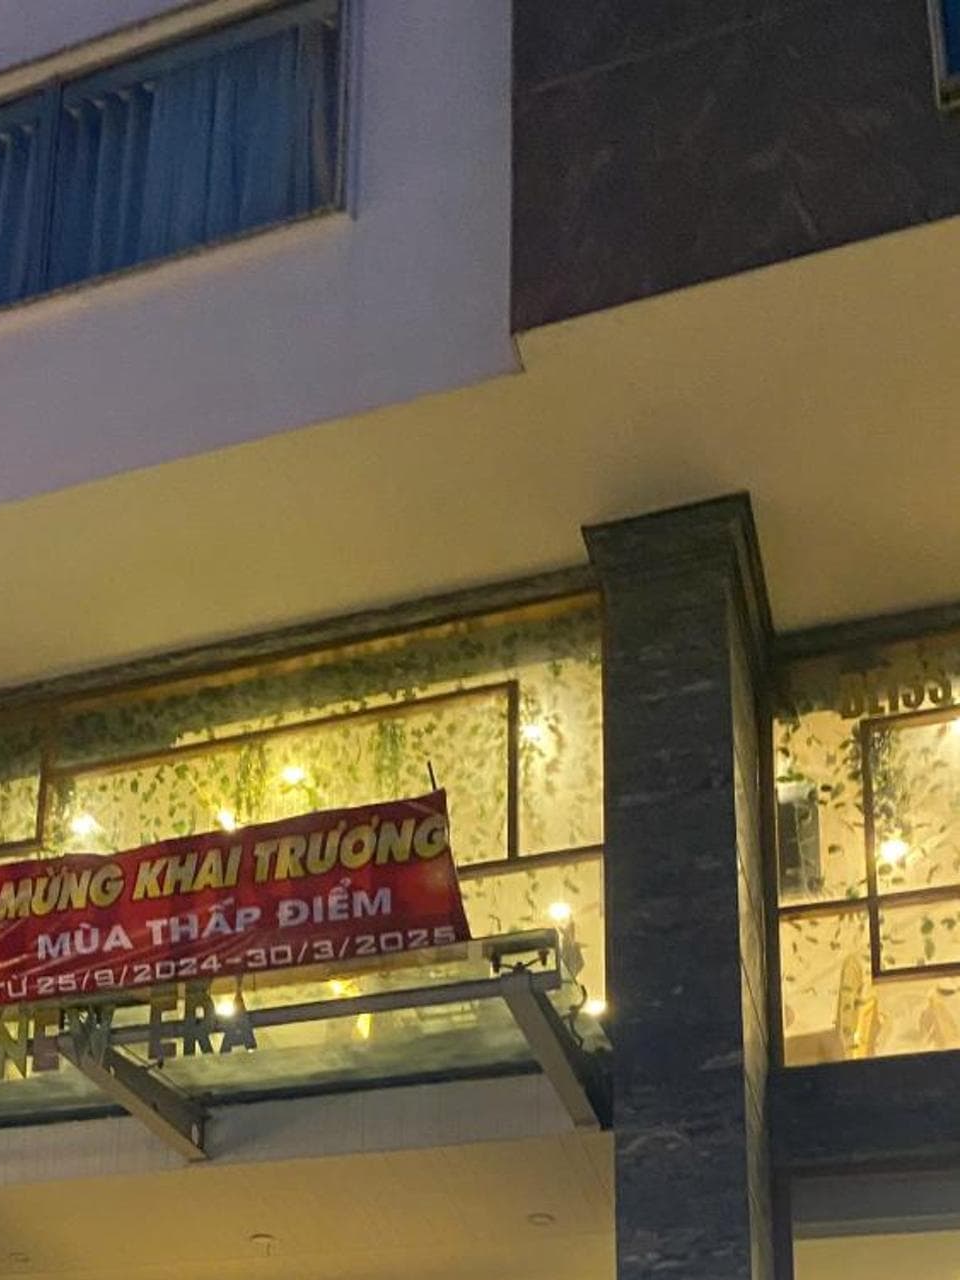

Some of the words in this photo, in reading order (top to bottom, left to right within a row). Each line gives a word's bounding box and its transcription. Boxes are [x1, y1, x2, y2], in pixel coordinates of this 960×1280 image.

[133, 845, 242, 901] KHAI
[38, 922, 133, 960] MÙA
[146, 897, 261, 945] THẤP
[278, 878, 391, 928] ĐIỂM
[149, 977, 258, 1060] ERA
